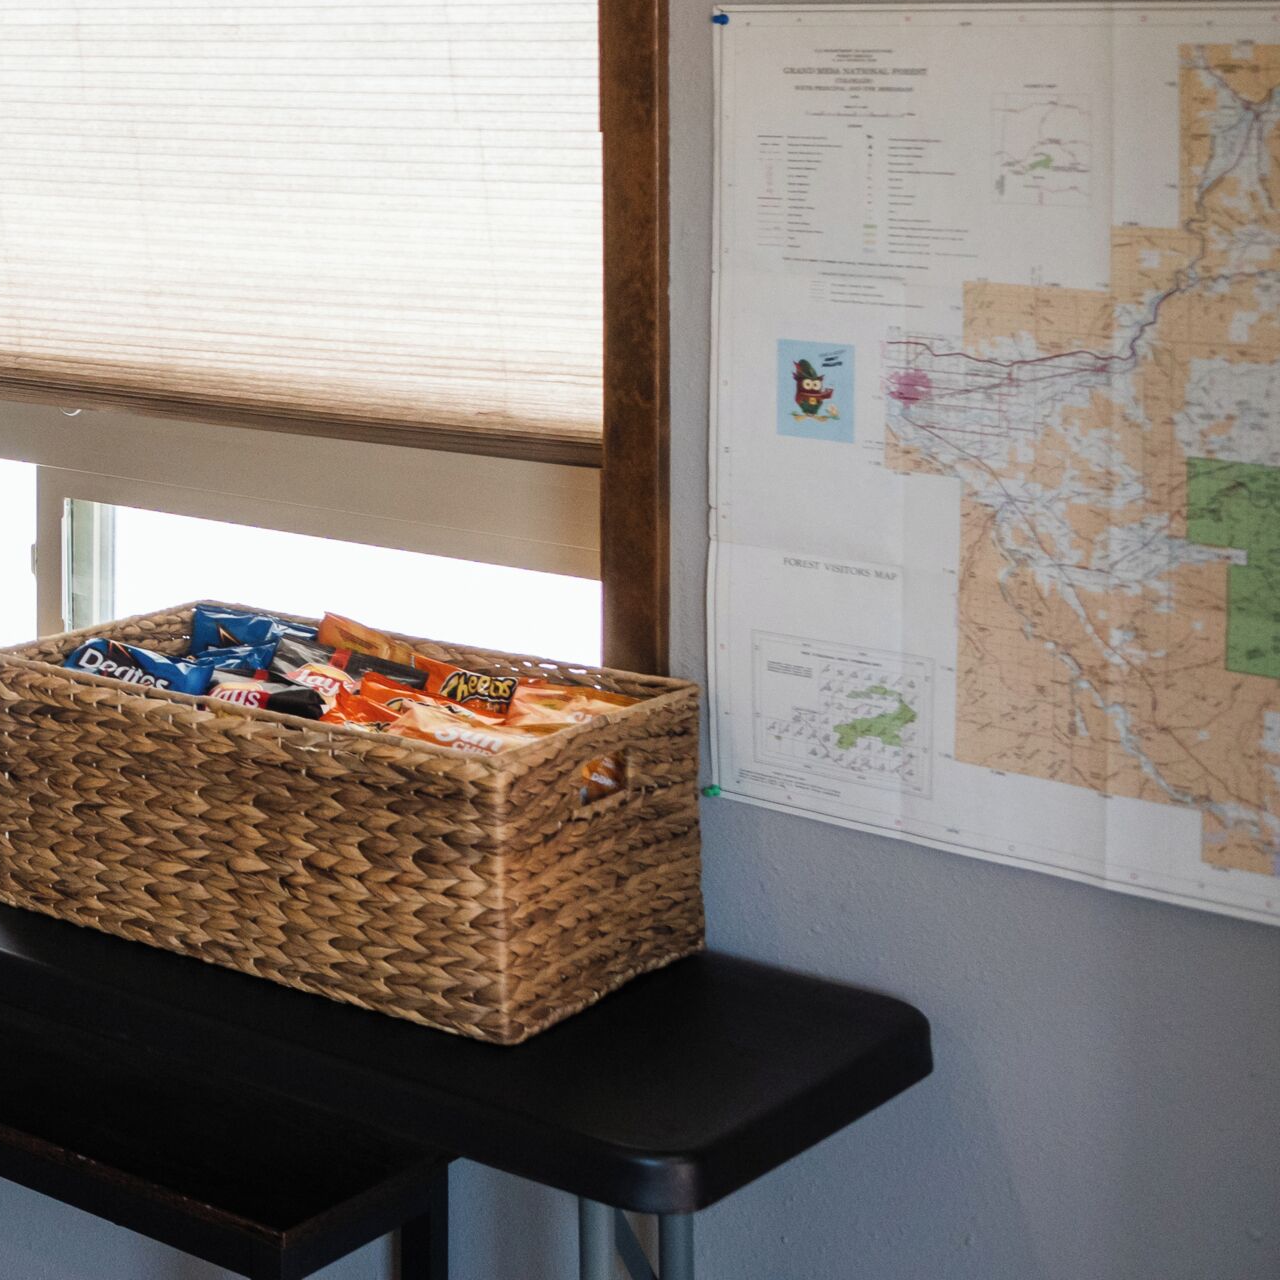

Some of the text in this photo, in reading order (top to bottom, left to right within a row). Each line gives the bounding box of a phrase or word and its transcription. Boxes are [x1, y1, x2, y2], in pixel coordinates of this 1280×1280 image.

[783, 557, 898, 581] FOREST VISITORS MAP
[78, 648, 169, 690] Doritos
